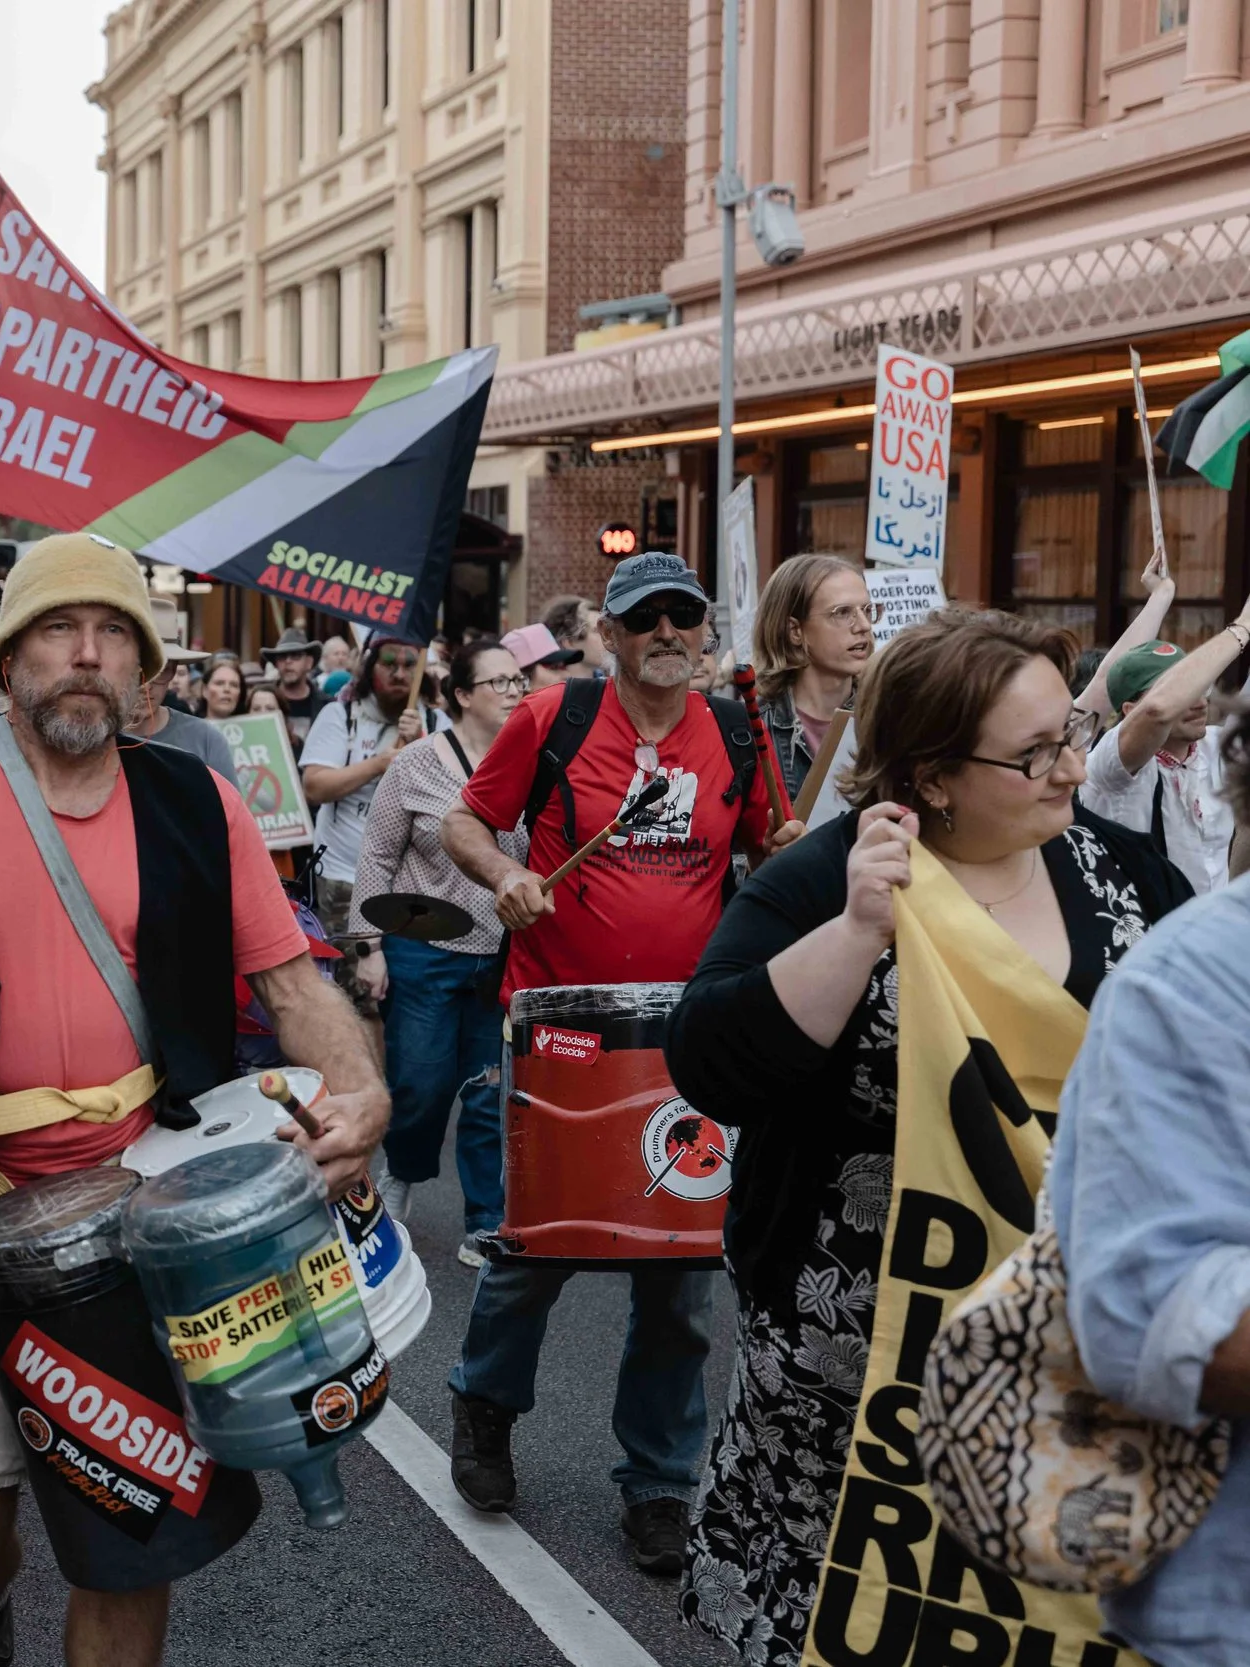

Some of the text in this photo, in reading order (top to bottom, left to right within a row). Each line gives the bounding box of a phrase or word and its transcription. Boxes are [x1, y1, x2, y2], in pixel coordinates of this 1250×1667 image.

[884, 356, 950, 402] GO
[881, 390, 949, 436] AWAY
[880, 421, 946, 481] USA
[255, 565, 407, 625] ALLIANCE
[870, 587, 904, 599] OGER
[234, 744, 271, 767] AR
[552, 1031, 596, 1048] Woodside
[552, 1043, 586, 1058] Ecocide
[652, 1104, 690, 1163] Drummers for
[178, 1306, 234, 1338] SAVE
[174, 1337, 222, 1362] STOP
[15, 1338, 211, 1494] WOODSIDE
[56, 1438, 161, 1515] FRACK FREE
